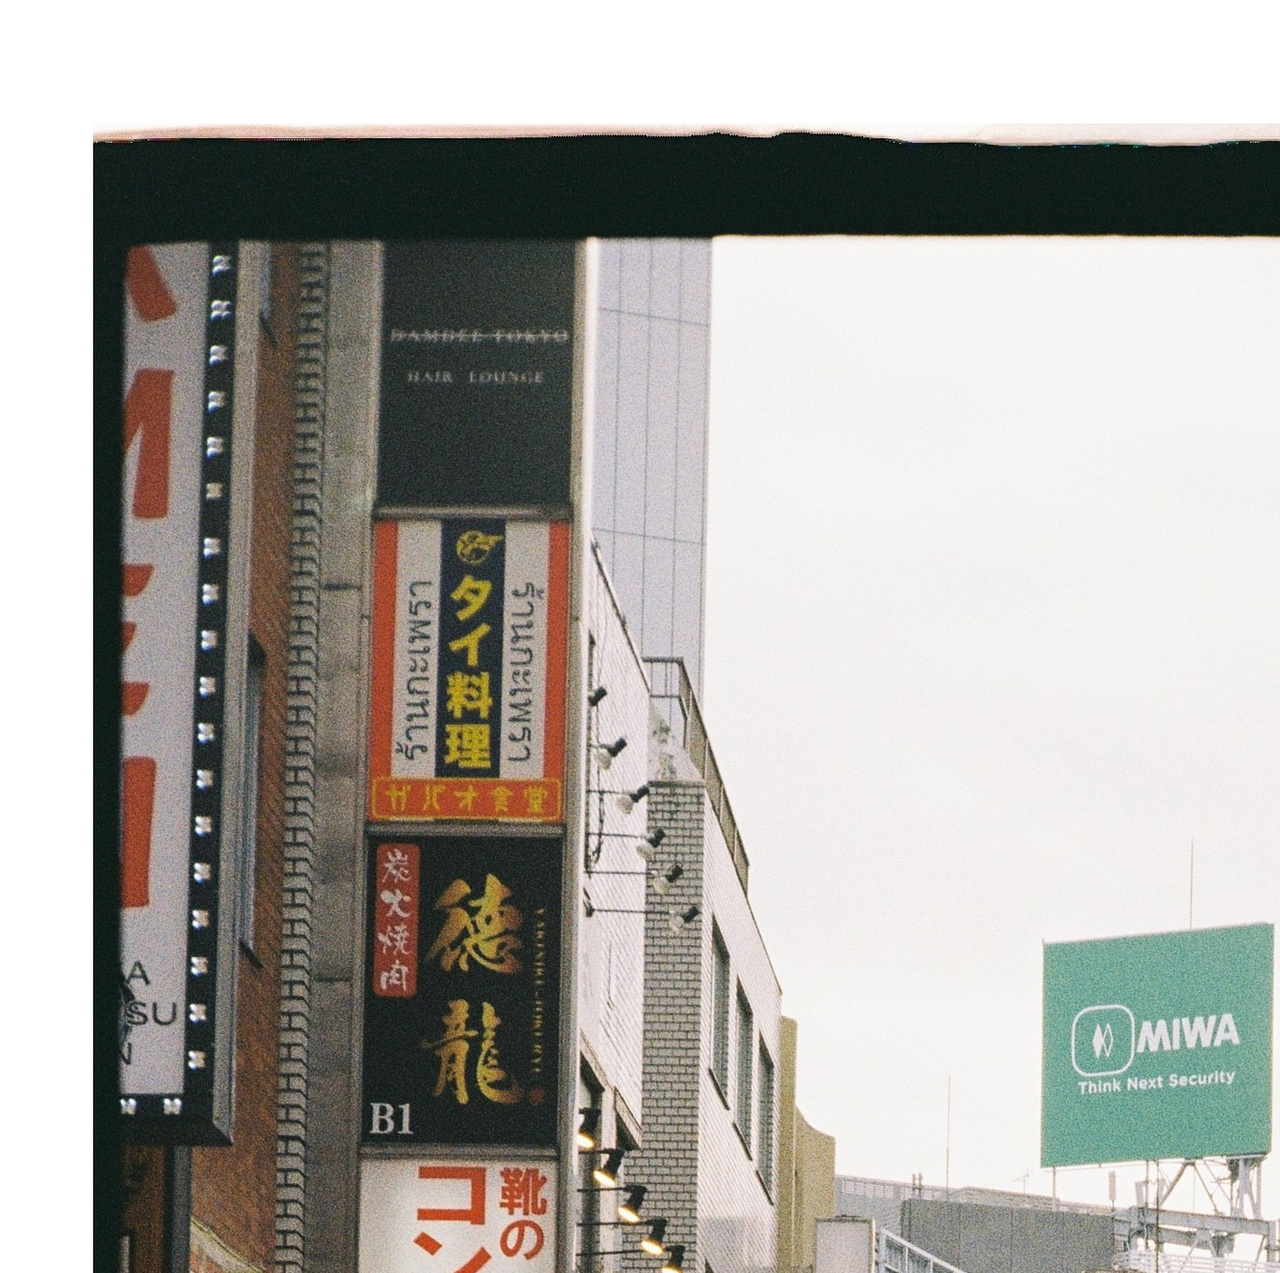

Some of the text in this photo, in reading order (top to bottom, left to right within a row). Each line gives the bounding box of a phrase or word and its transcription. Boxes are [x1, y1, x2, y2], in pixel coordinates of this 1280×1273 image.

[408, 370, 452, 383] HAIR
[445, 574, 493, 769] タイ料理
[1136, 1013, 1240, 1054] MIWA
[1078, 1068, 1236, 1095] Think Next Security
[369, 1102, 414, 1135] B1
[499, 1166, 547, 1260] 靴の
